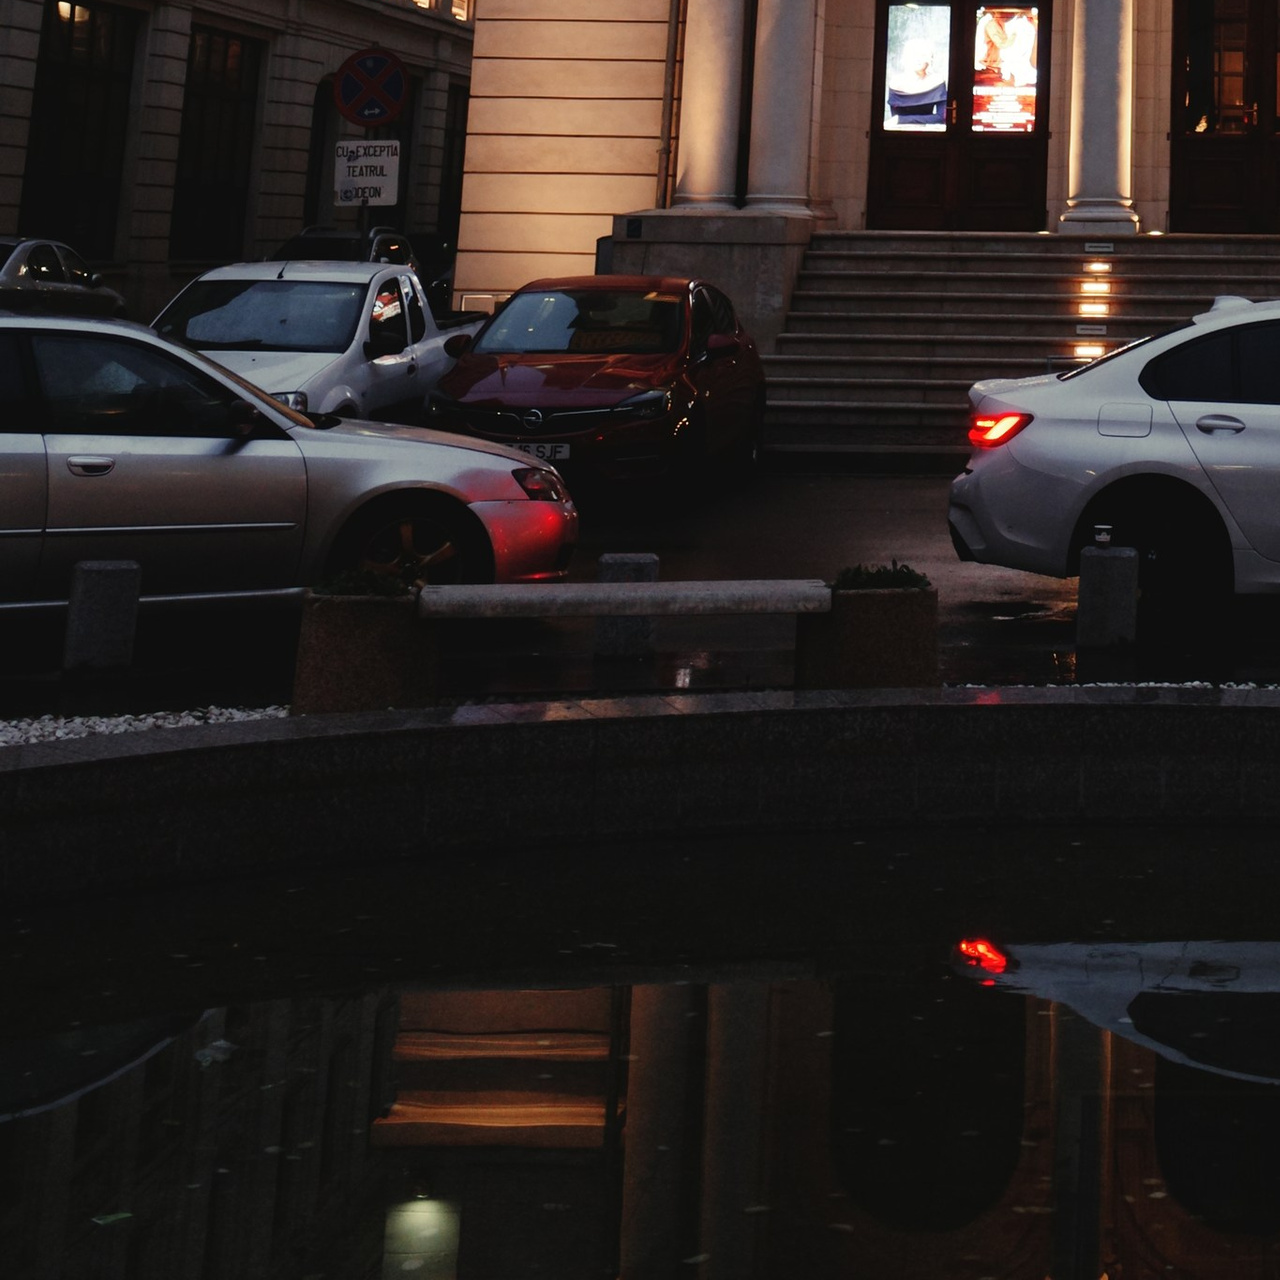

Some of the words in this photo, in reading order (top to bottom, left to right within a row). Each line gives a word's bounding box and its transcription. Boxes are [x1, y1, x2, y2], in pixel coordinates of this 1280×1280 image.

[336, 145, 349, 158] CU
[347, 165, 388, 178] TEATRUL
[535, 444, 564, 459] SJF
